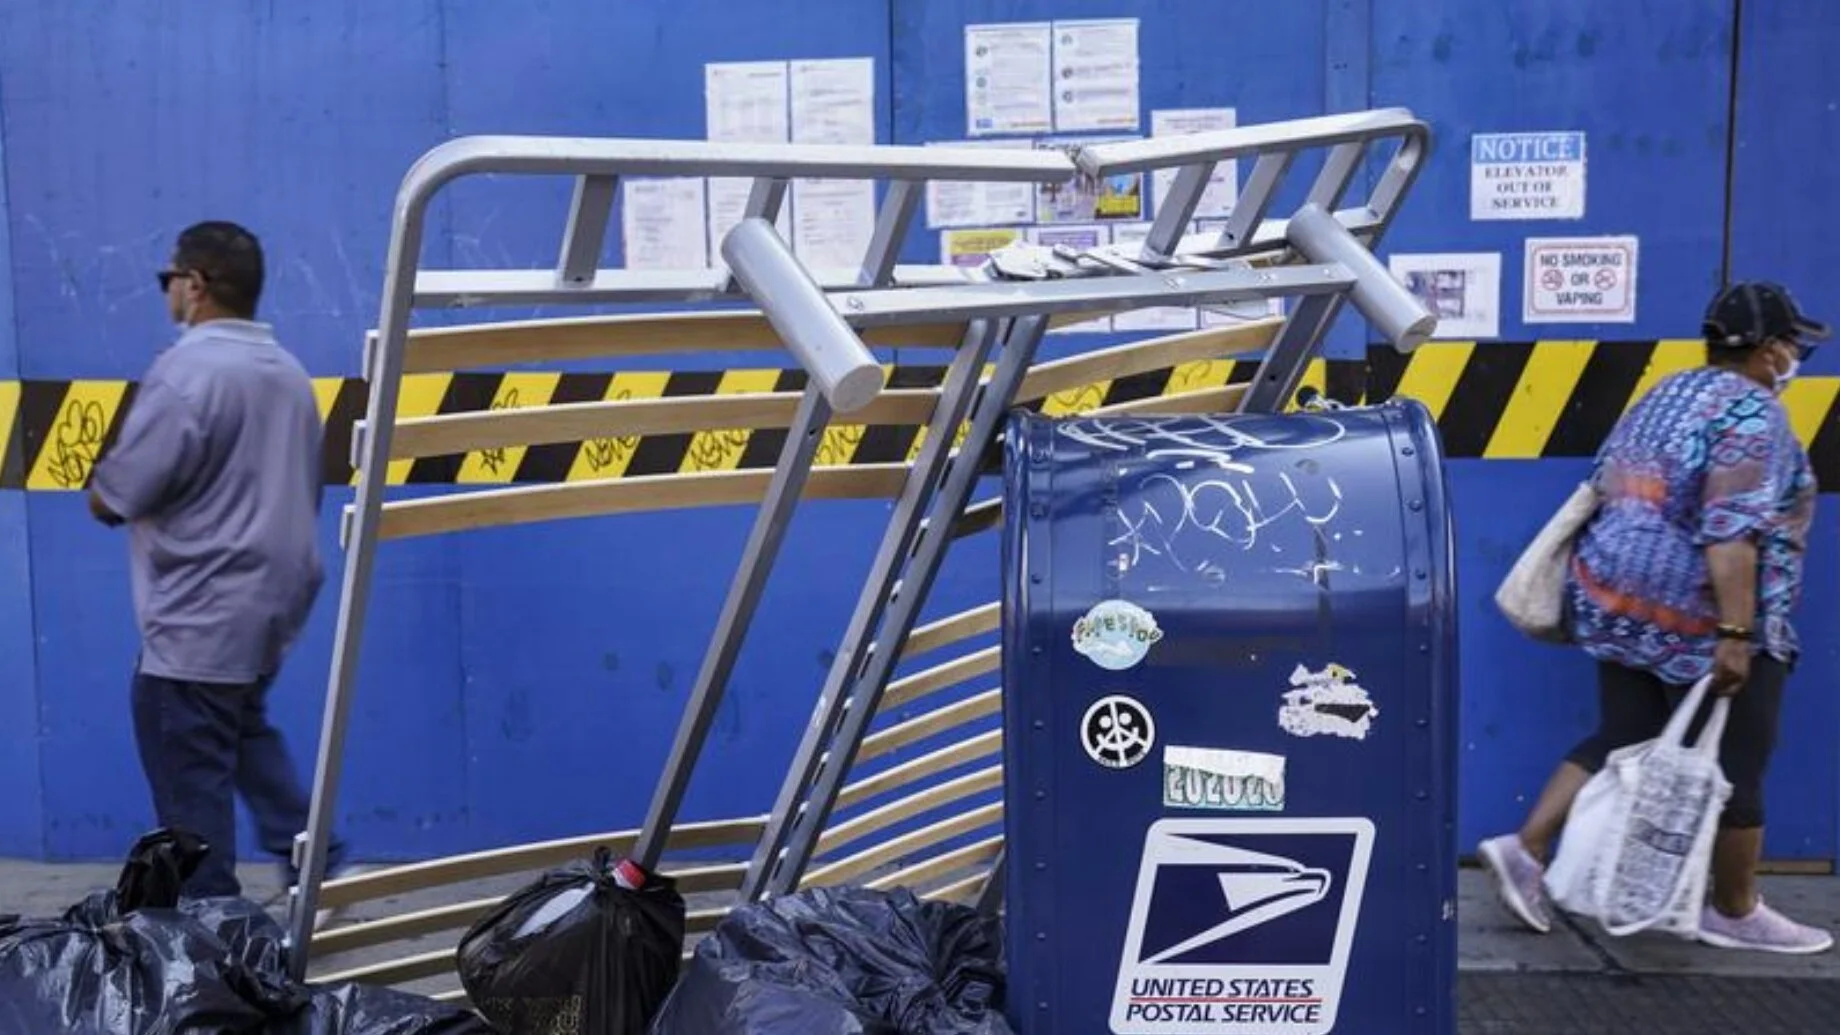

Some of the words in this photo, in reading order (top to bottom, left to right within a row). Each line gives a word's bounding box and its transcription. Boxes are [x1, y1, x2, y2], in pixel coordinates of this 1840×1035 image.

[1480, 138, 1574, 160] NOTICE
[1485, 165, 1567, 178] ELEVATOR
[1496, 181, 1529, 193] OUT
[1532, 181, 1552, 193] OF
[1492, 196, 1558, 209] SERVICE
[1540, 252, 1558, 267] NO
[1562, 252, 1623, 268] SMOKING
[1570, 272, 1590, 286] OR
[1556, 291, 1603, 305] VAPING
[1131, 978, 1225, 997] UNITED
[1227, 978, 1314, 998] STATES
[1126, 1003, 1215, 1022] POSTAL
[1221, 1003, 1321, 1024] SERVICE
